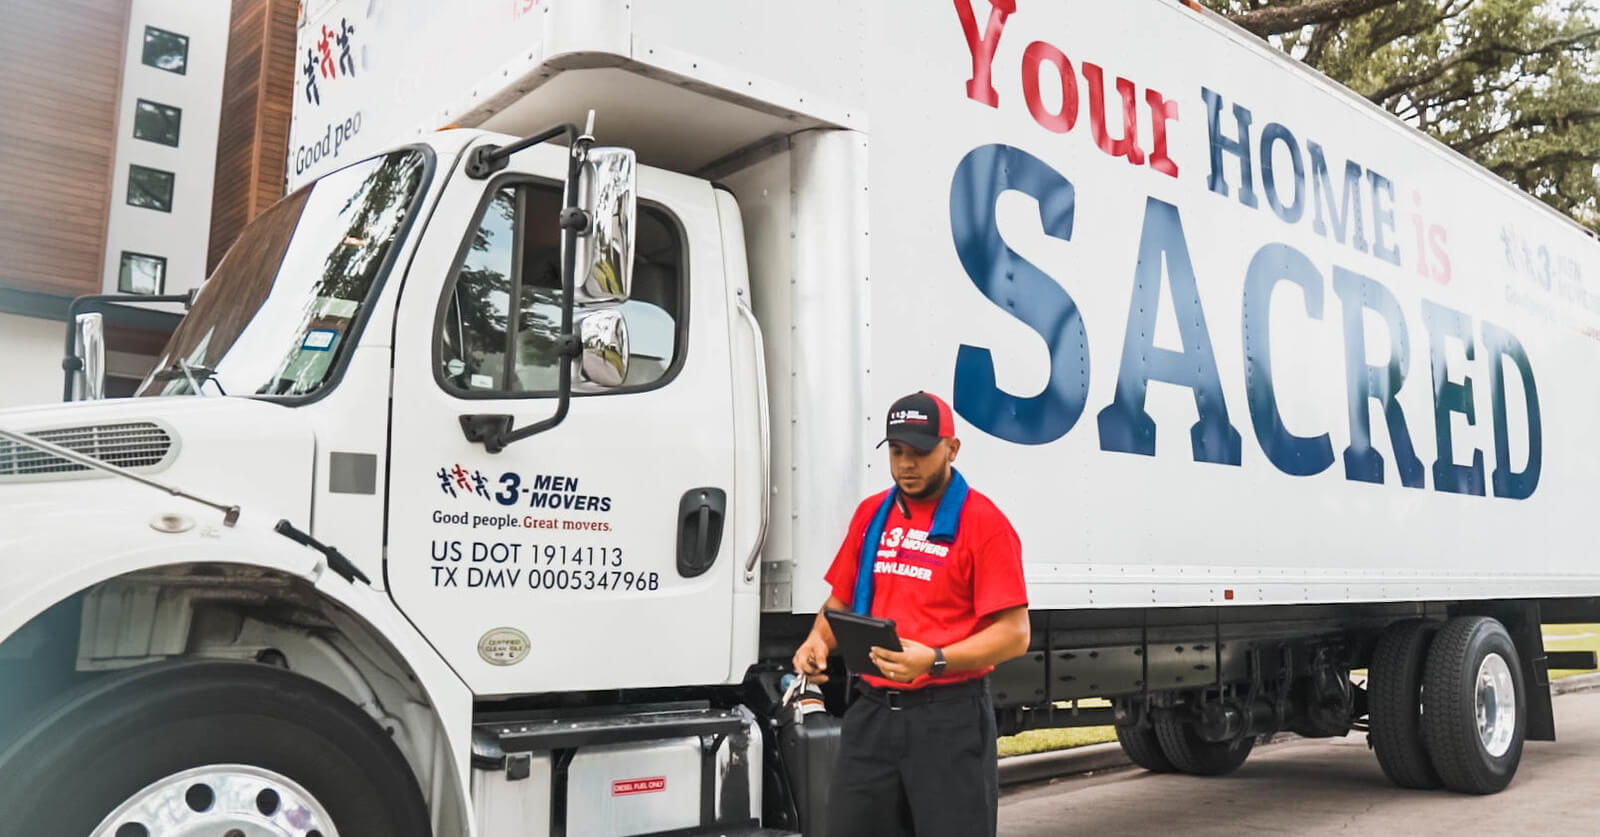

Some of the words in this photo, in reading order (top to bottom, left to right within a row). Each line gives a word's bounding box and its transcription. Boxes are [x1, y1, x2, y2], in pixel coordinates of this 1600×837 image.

[296, 123, 331, 176] Good
[954, 0, 1179, 179] Your
[1201, 86, 1401, 266] HOME
[1412, 189, 1452, 286] is
[949, 143, 1543, 501] SACRED
[534, 475, 578, 492] MEN
[530, 492, 612, 512] MOVERS
[432, 510, 469, 525] Good
[473, 514, 521, 529] people.
[523, 515, 559, 529] Great
[562, 520, 612, 531] movers.
[431, 540, 462, 562] US
[472, 542, 522, 563] DOT
[532, 545, 623, 567] 1914113
[901, 538, 949, 557] MOVERS
[431, 566, 458, 587] TX
[467, 568, 521, 588] DMV
[528, 569, 659, 591] 000534796B
